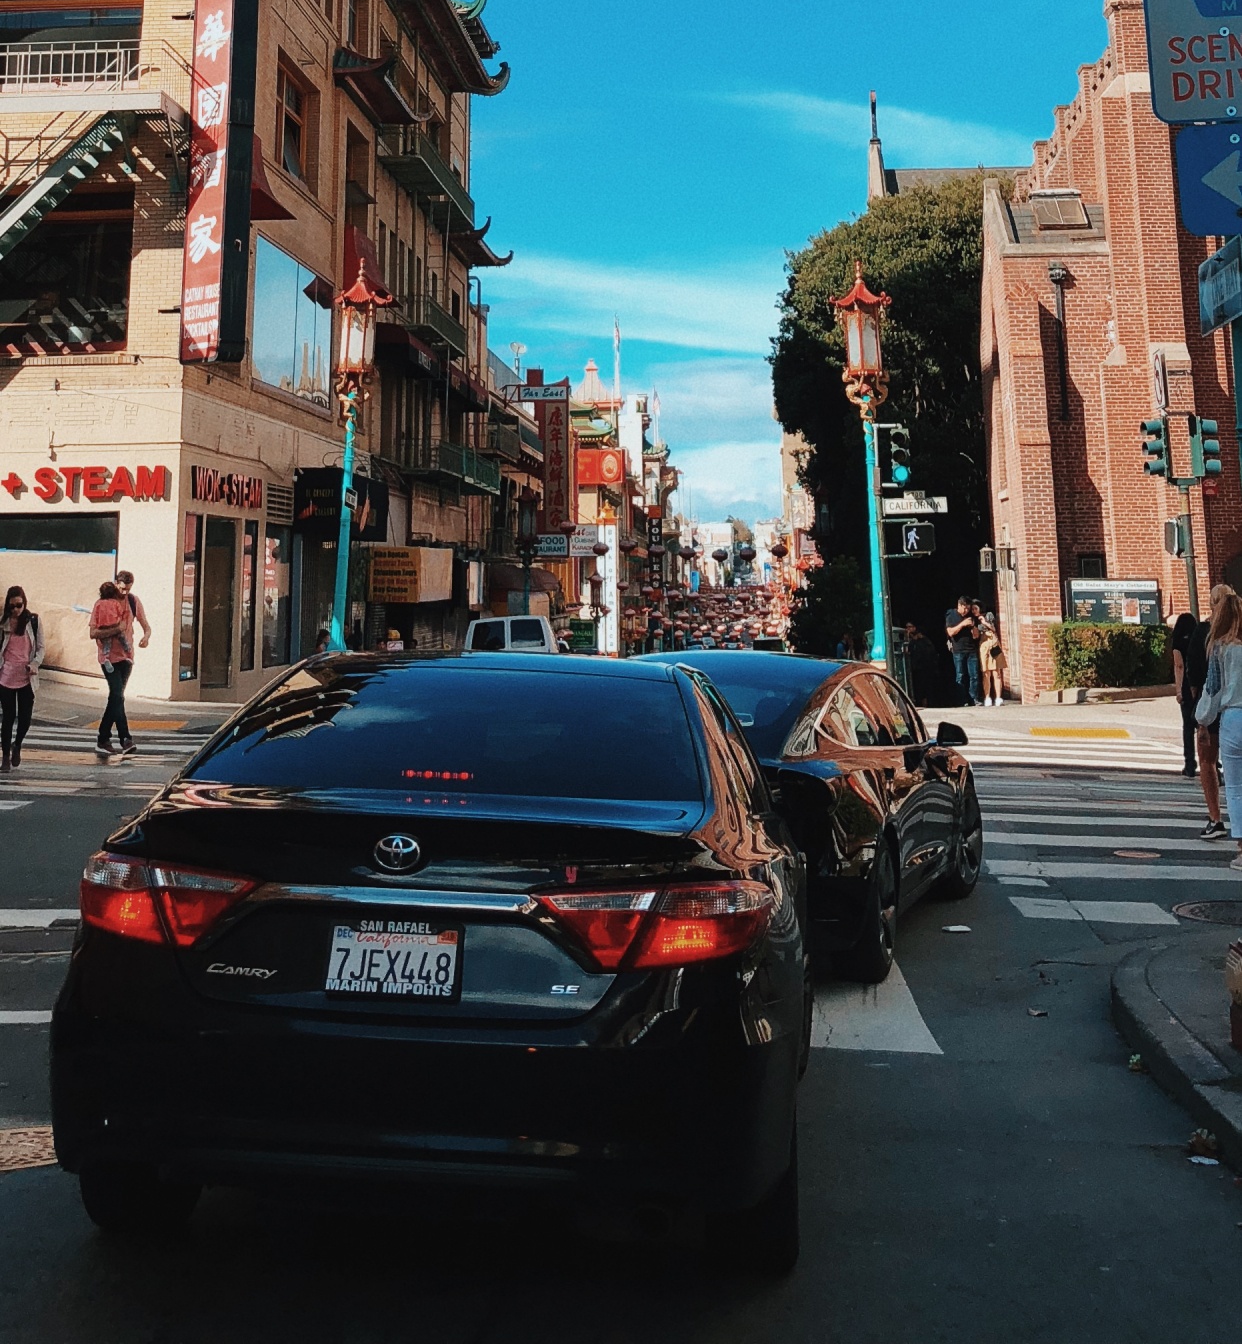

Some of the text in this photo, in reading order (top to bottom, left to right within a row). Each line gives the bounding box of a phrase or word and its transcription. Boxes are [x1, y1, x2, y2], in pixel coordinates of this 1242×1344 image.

[185, 282, 220, 304] CATHAY HOUSE
[184, 301, 219, 321] RESTAURANT
[523, 387, 564, 398] Far East
[34, 465, 165, 498] STEAM
[194, 466, 220, 502] WOK
[230, 473, 262, 509] STEAM
[889, 501, 942, 510] CALIFORNIA
[537, 545, 566, 553] AURANT
[337, 927, 353, 938] DEC
[360, 920, 431, 934] SAN RAFAEL
[356, 931, 434, 948] California
[206, 962, 278, 979] CAMRY
[336, 947, 451, 985] 7JEX448
[325, 978, 453, 996] MARIN IMPORTS
[550, 984, 580, 994] SE
